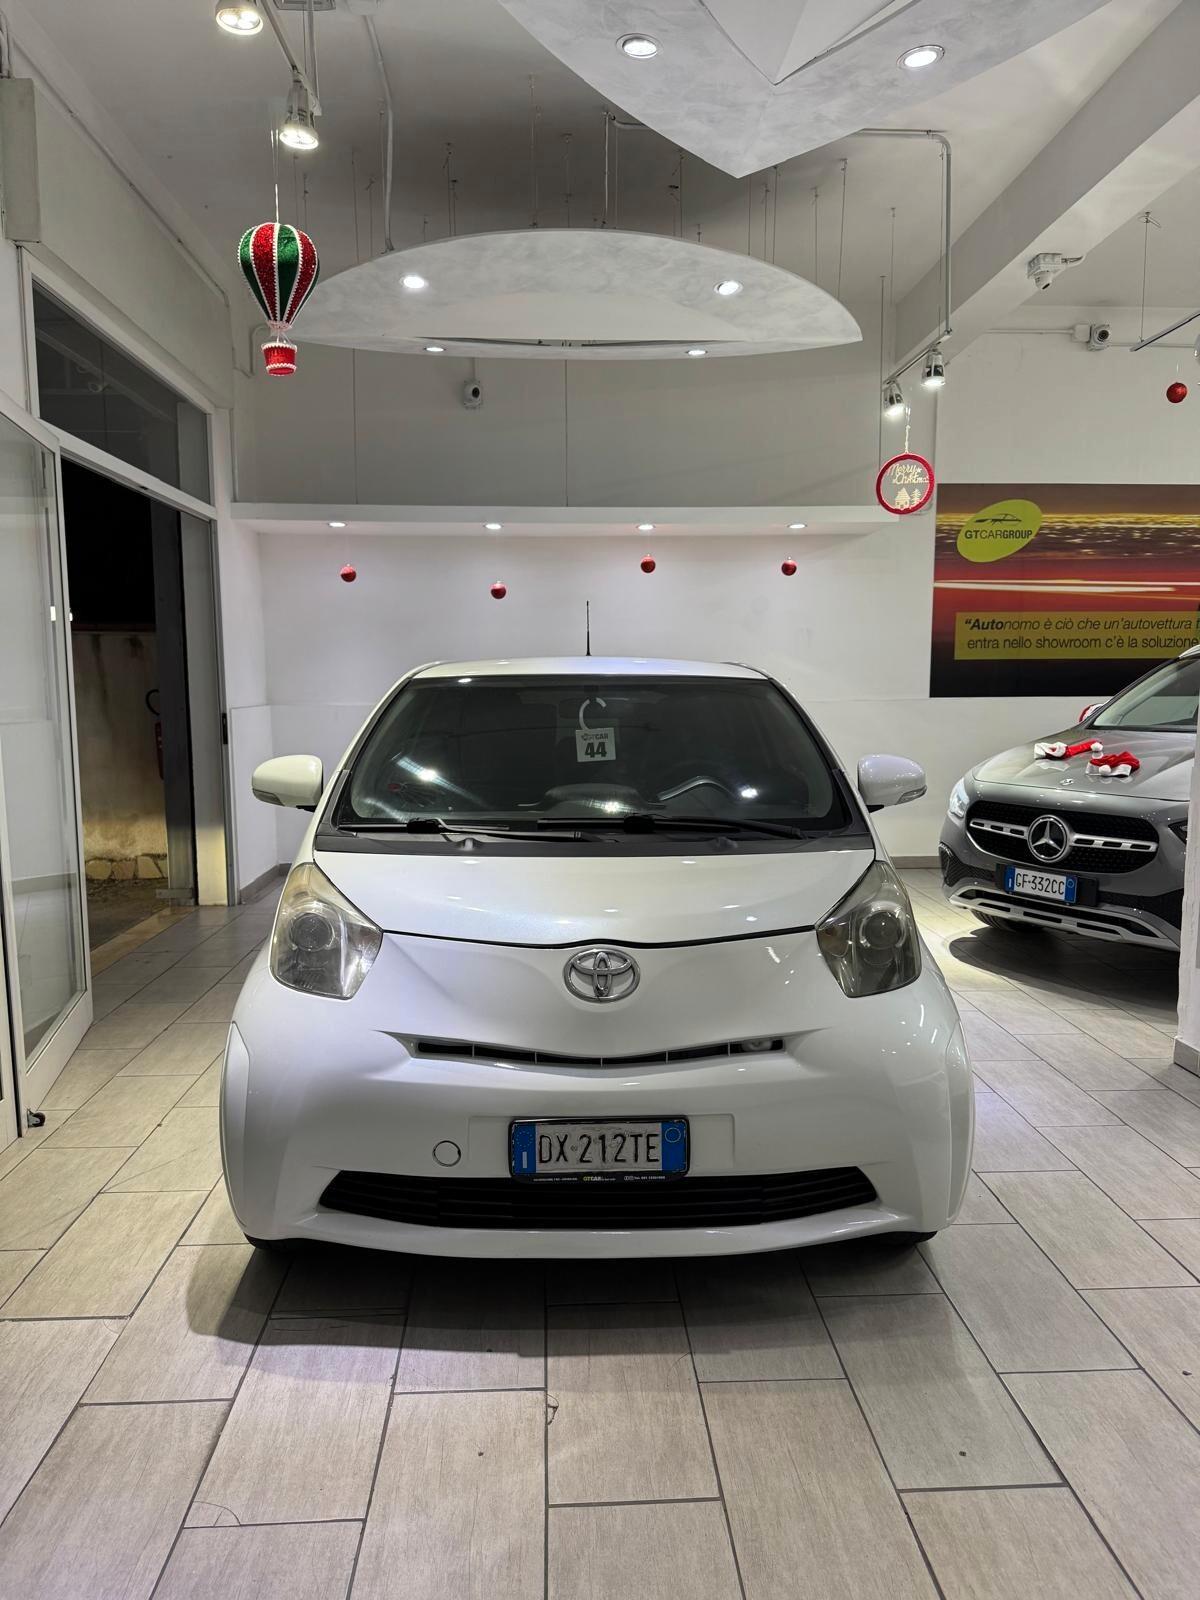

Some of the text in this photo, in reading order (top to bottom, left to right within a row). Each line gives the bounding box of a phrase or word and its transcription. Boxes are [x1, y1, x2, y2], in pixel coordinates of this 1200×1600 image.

[1043, 617, 1053, 631] è
[1055, 617, 1074, 631] ciò
[1077, 617, 1101, 631] che
[967, 637, 1000, 649] entra
[1003, 635, 1033, 649] nello
[1035, 635, 1102, 649] showroom
[1127, 635, 1138, 649] la
[1141, 635, 1200, 649] soluzione
[584, 741, 607, 758] 44
